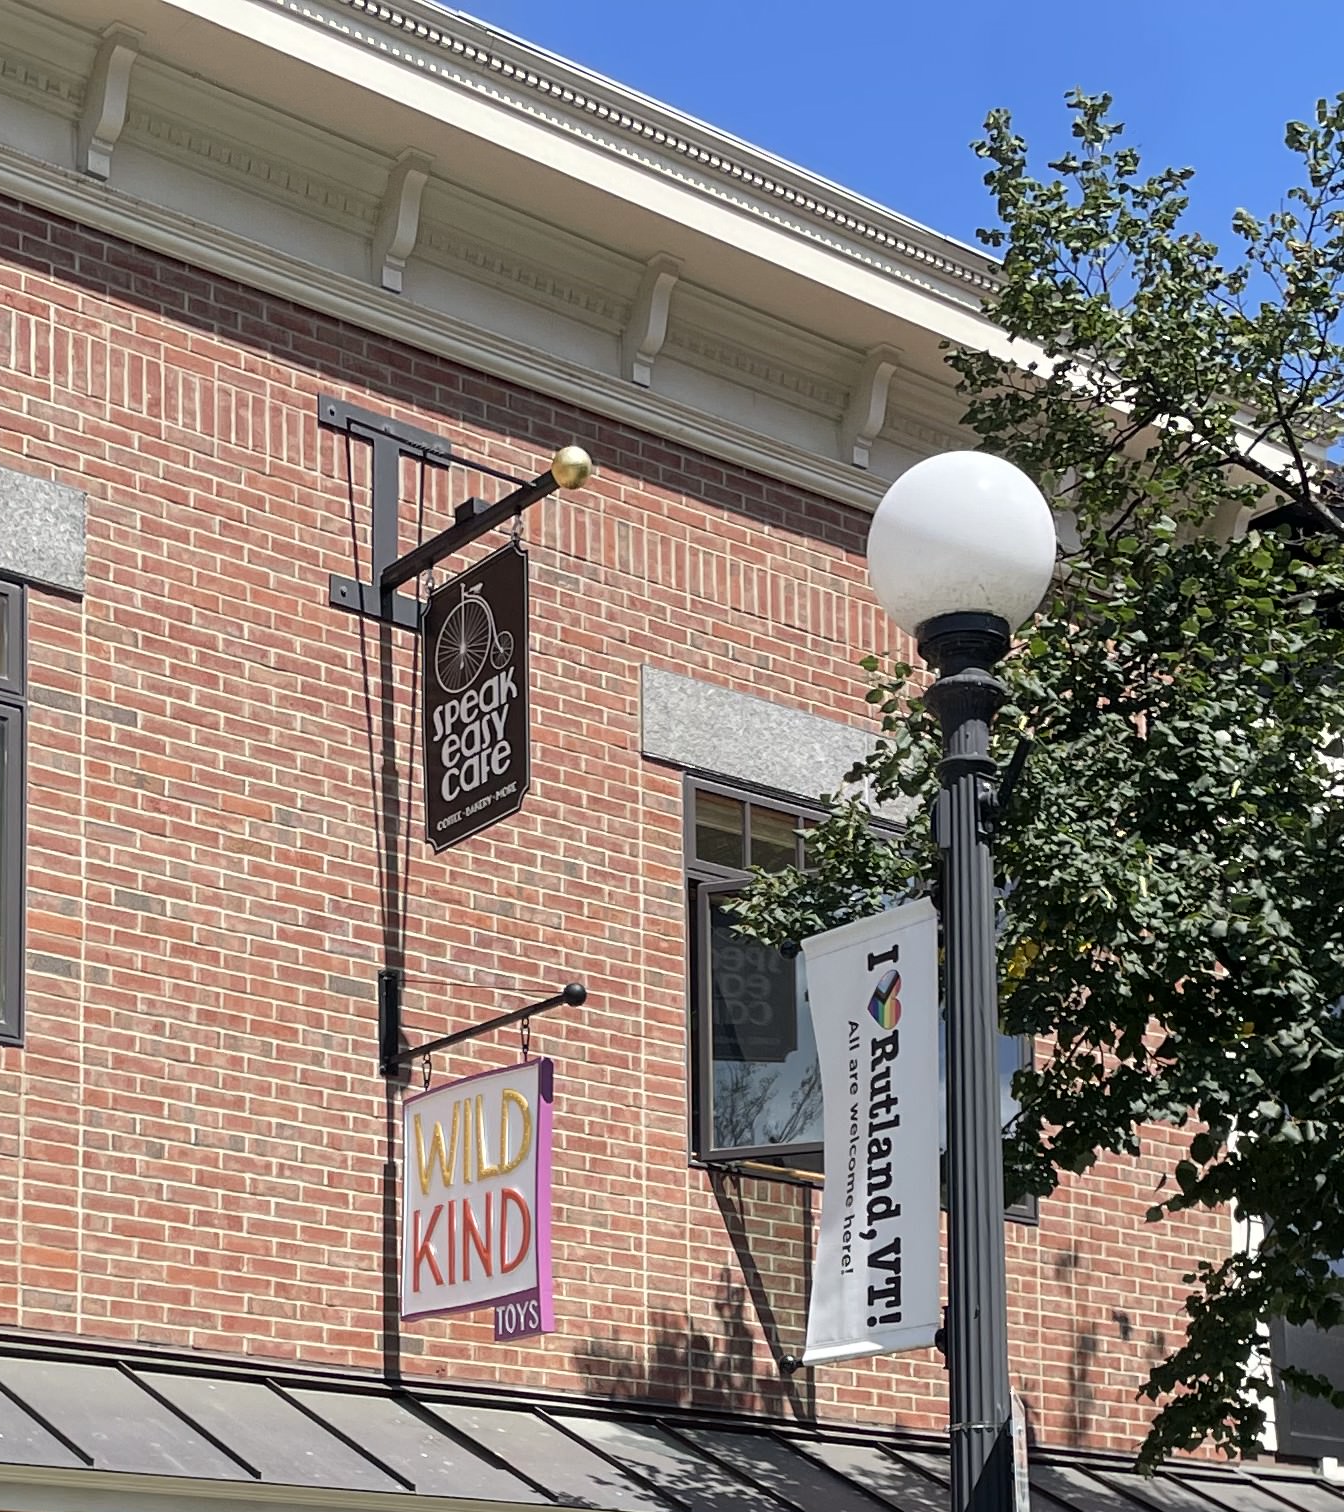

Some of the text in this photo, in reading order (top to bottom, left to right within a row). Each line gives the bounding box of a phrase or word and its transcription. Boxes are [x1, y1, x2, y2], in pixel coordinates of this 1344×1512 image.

[414, 1088, 531, 1195] WILD
[841, 1021, 860, 1276] All are welcome here!
[413, 1187, 531, 1292] KIND
[496, 1300, 539, 1336] TOYS
